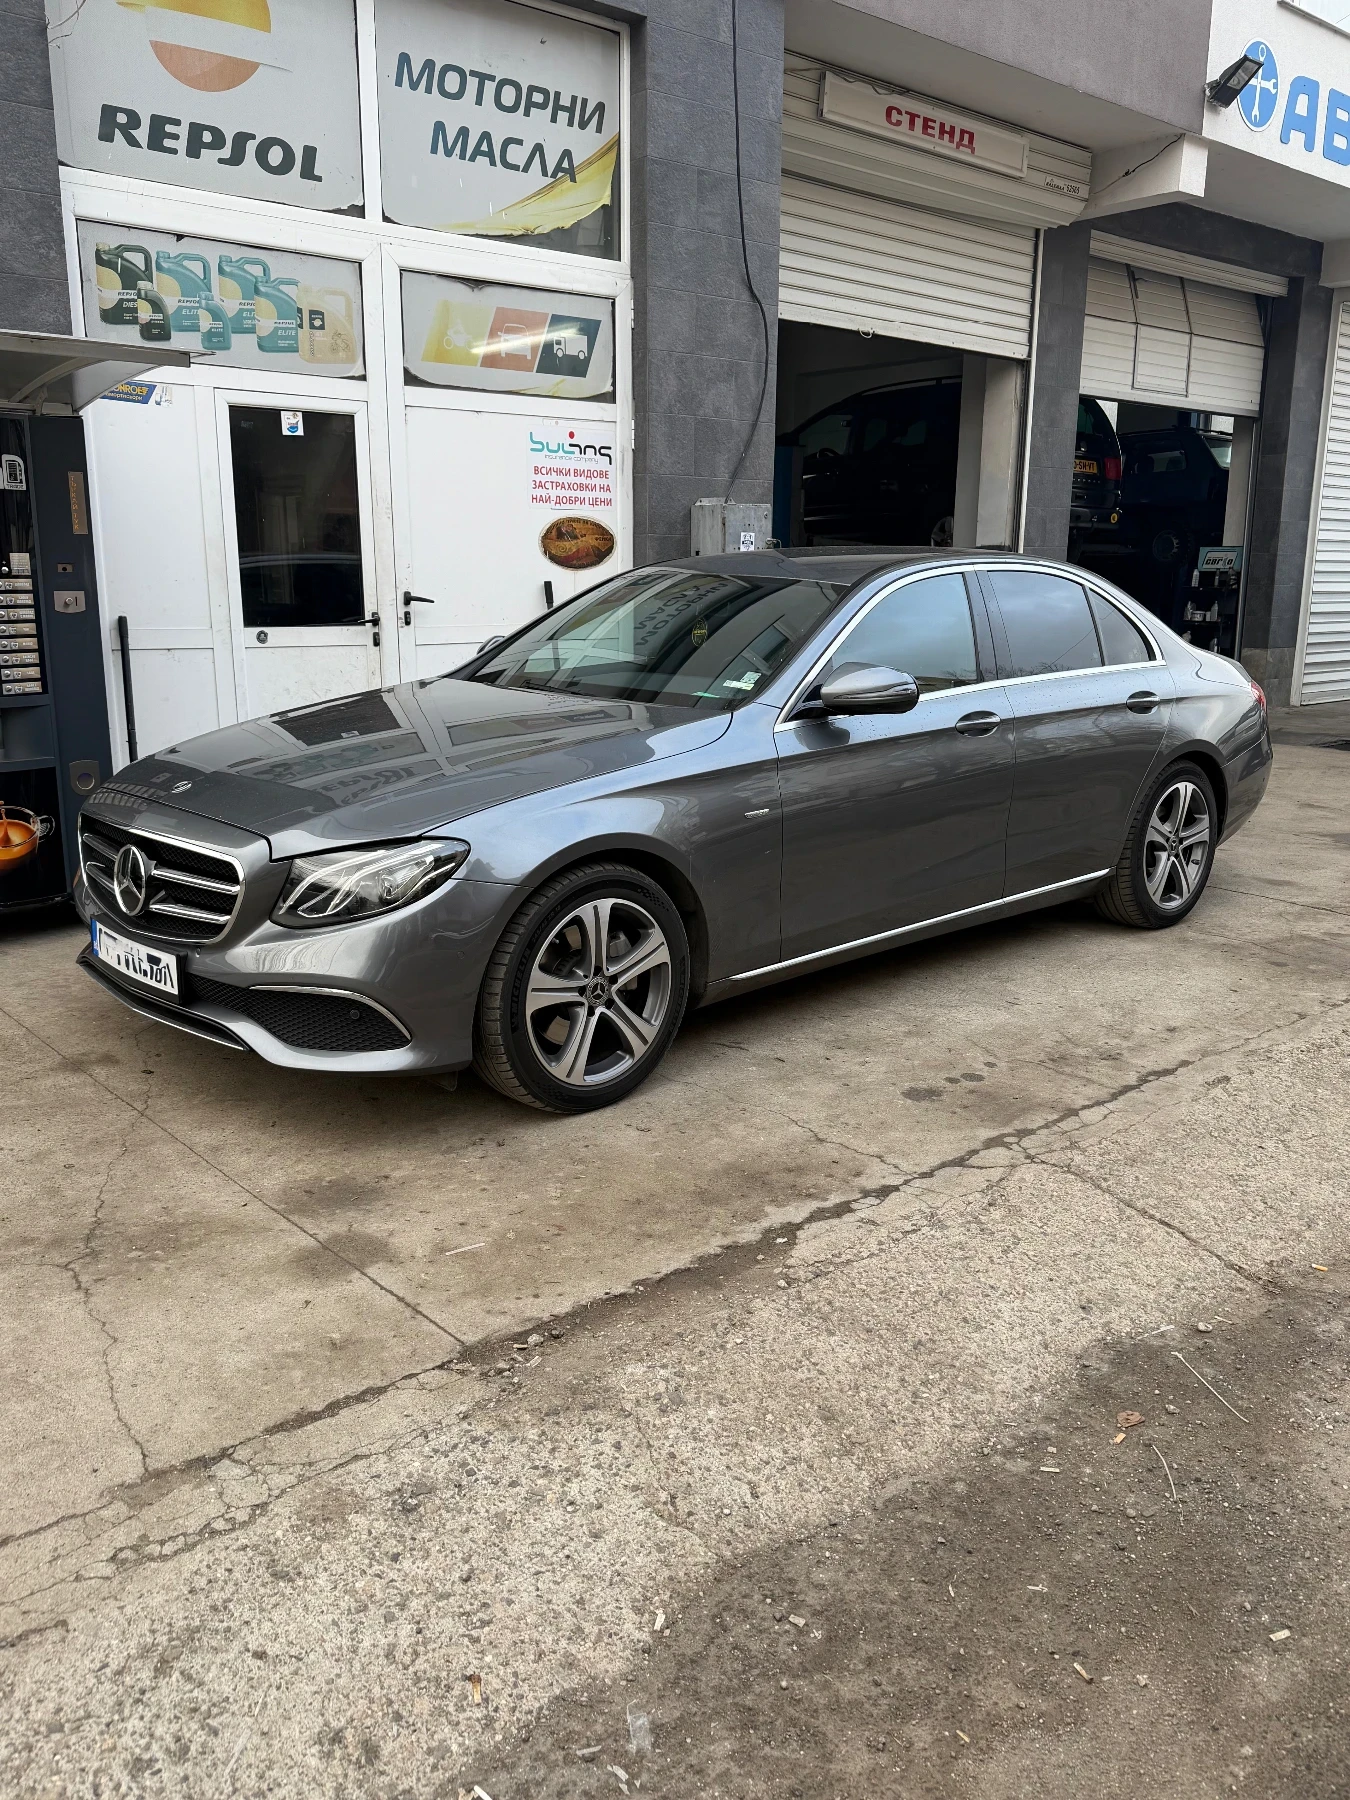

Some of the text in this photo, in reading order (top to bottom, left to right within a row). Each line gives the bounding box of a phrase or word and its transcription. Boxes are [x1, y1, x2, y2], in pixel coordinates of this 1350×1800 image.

[394, 51, 606, 134] МОТОРНИ
[97, 103, 323, 183] REPSOL
[429, 120, 577, 184] МАСЛА
[885, 105, 976, 155] СТЕНД
[531, 479, 612, 494] ЗАСТРАХОВКИ НА
[533, 465, 610, 480] ВСИЧКИ ВИДОВЕ
[531, 492, 613, 508] НАЙ-ДОБРИ ЦЕНИ
